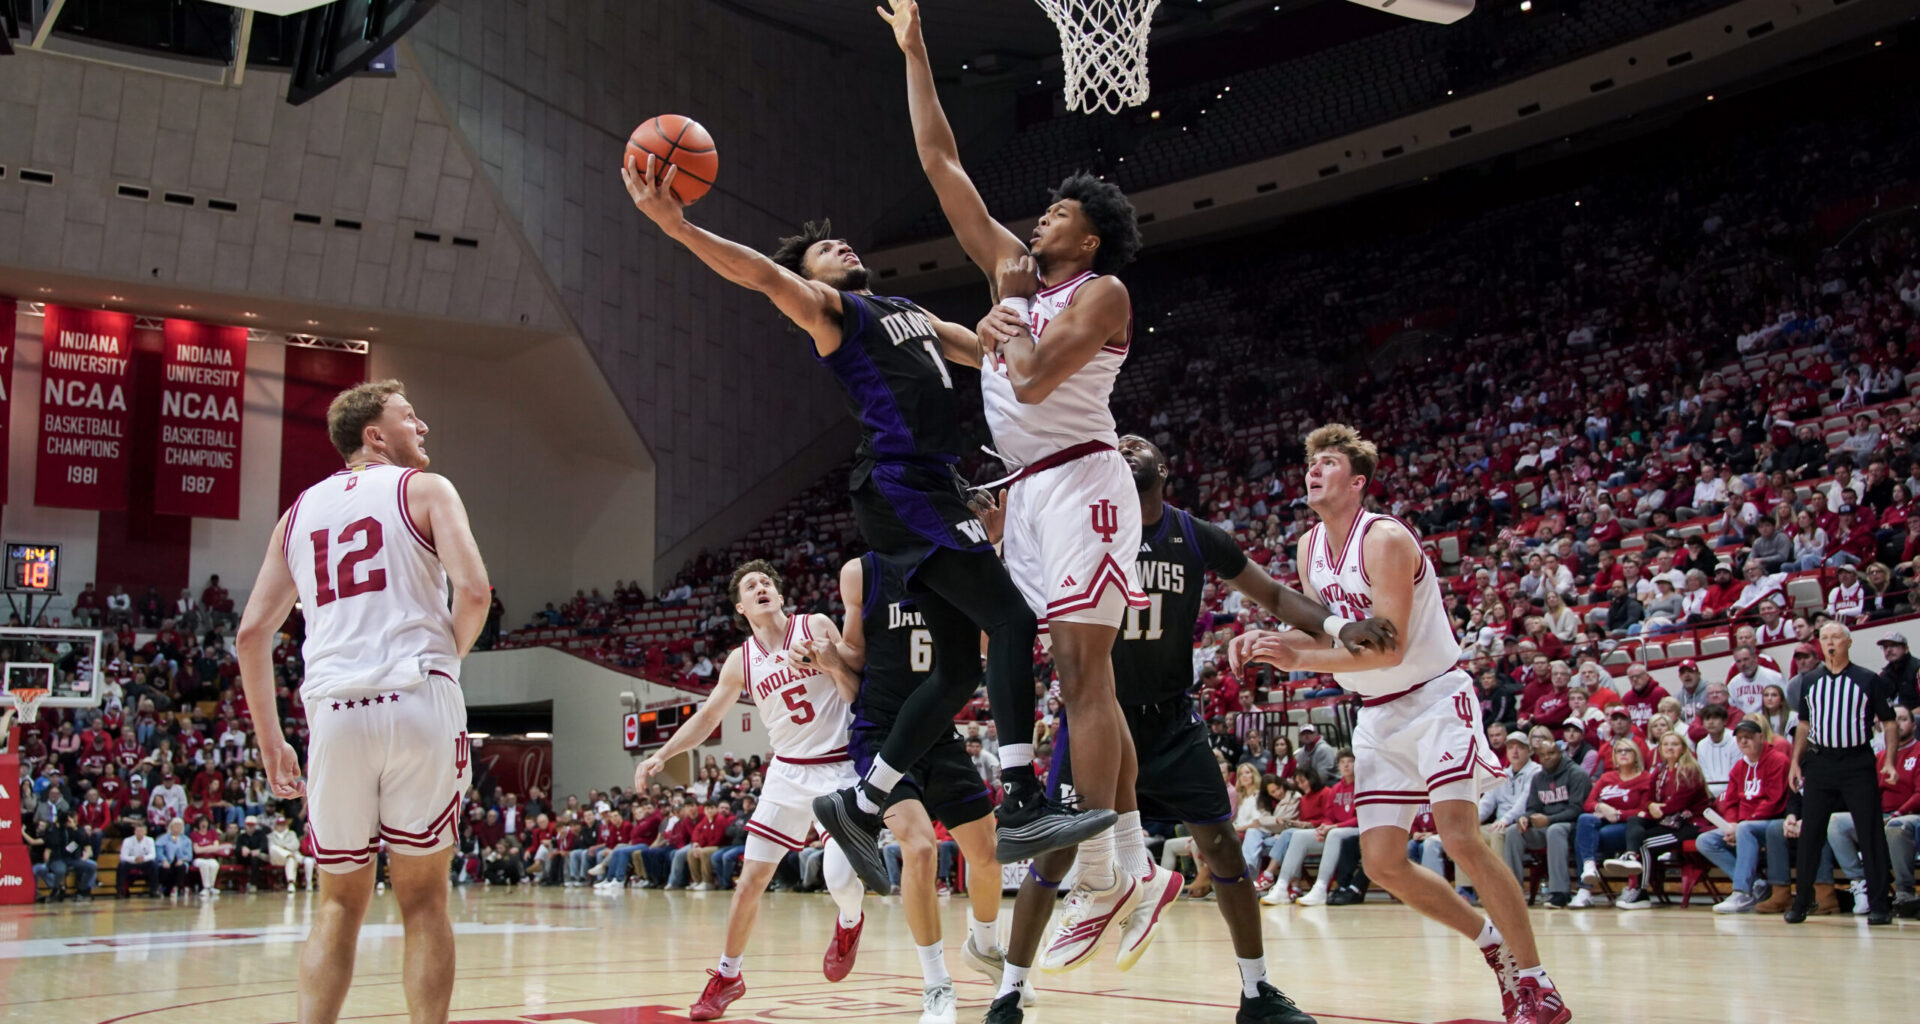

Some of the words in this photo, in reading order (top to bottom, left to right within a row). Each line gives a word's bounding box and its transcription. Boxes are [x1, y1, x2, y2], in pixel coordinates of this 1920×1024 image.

[60, 331, 119, 354] INDIANA
[49, 352, 127, 376] UNIVERSITY
[177, 344, 232, 366] INDIANA
[923, 340, 953, 389] 1
[167, 364, 240, 387] UNIVERSITY
[44, 378, 127, 411] NCAA
[162, 390, 240, 422] NCAA
[45, 414, 123, 437] BASKETBALL
[163, 425, 236, 448] BASKETBALL
[47, 437, 119, 459] CHAMPIONS
[165, 448, 233, 469] CHAMPIONS
[67, 465, 98, 485] 1981
[182, 475, 215, 494] 1987
[956, 519, 989, 544] W
[25, 548, 55, 561] 1:41
[310, 516, 387, 607] 12
[24, 562, 49, 588] 18
[1123, 593, 1164, 641] 11
[910, 629, 933, 672] 6
[781, 684, 815, 725] 5
